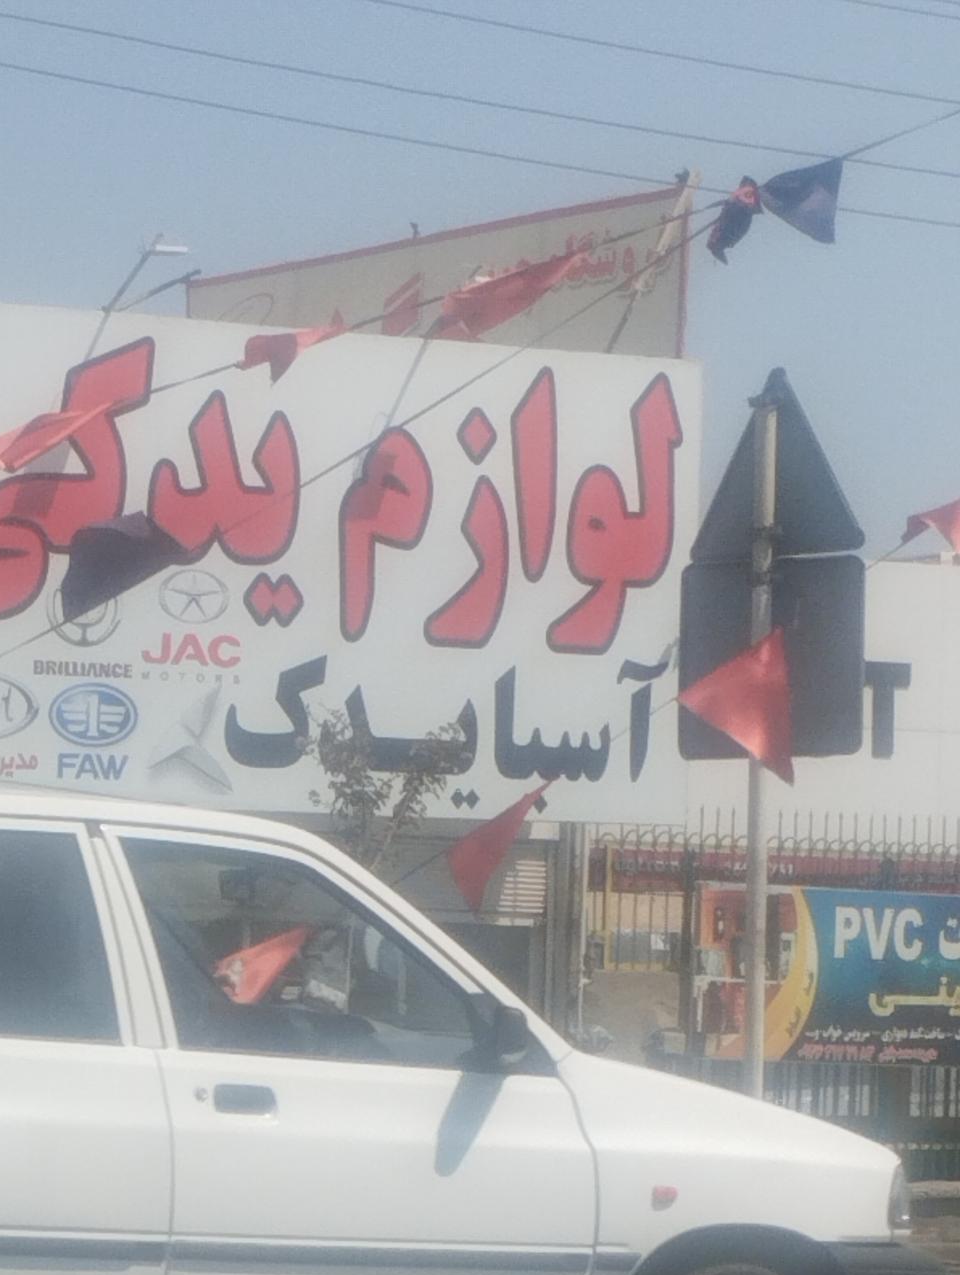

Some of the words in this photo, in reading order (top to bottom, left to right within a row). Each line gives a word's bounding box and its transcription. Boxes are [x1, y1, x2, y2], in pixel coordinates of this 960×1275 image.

[339, 364, 683, 655] لوازم
[32, 659, 134, 680] BRILLIANCE
[141, 632, 242, 669] JAC
[224, 653, 481, 814] یدک
[56, 752, 129, 780] FAW
[833, 905, 924, 962] PVC
